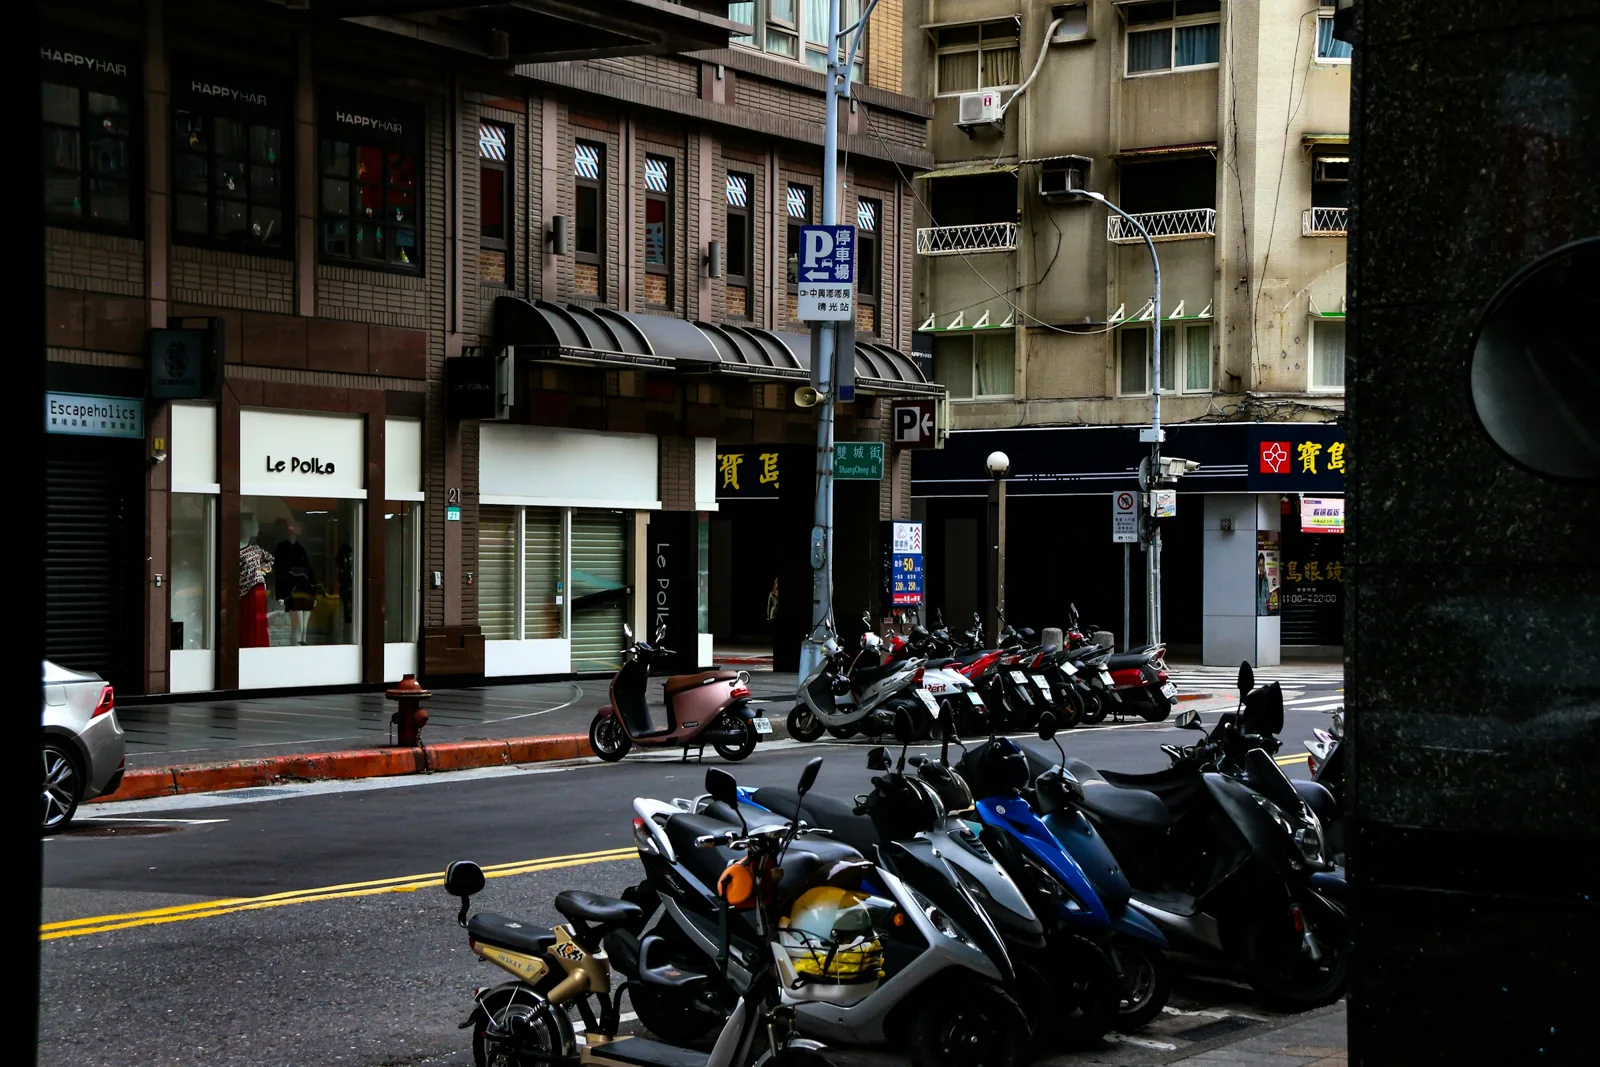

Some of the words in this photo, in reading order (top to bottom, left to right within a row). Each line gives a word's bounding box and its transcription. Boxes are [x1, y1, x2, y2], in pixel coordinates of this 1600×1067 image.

[40, 46, 128, 77] HAPPYHAIR
[192, 80, 268, 107] HAPPYHAIR
[336, 111, 403, 134] HAPPYHAIR
[803, 229, 834, 268] P
[834, 229, 851, 280] 停車場
[51, 400, 136, 420] Escapeholics
[897, 409, 917, 440] P
[266, 455, 286, 472] Le
[291, 456, 335, 475] Polka
[836, 445, 881, 460] 雙城街
[1296, 440, 1346, 476] 寶島
[449, 487, 460, 503] 21
[656, 543, 670, 568] Le
[903, 557, 914, 572] 50
